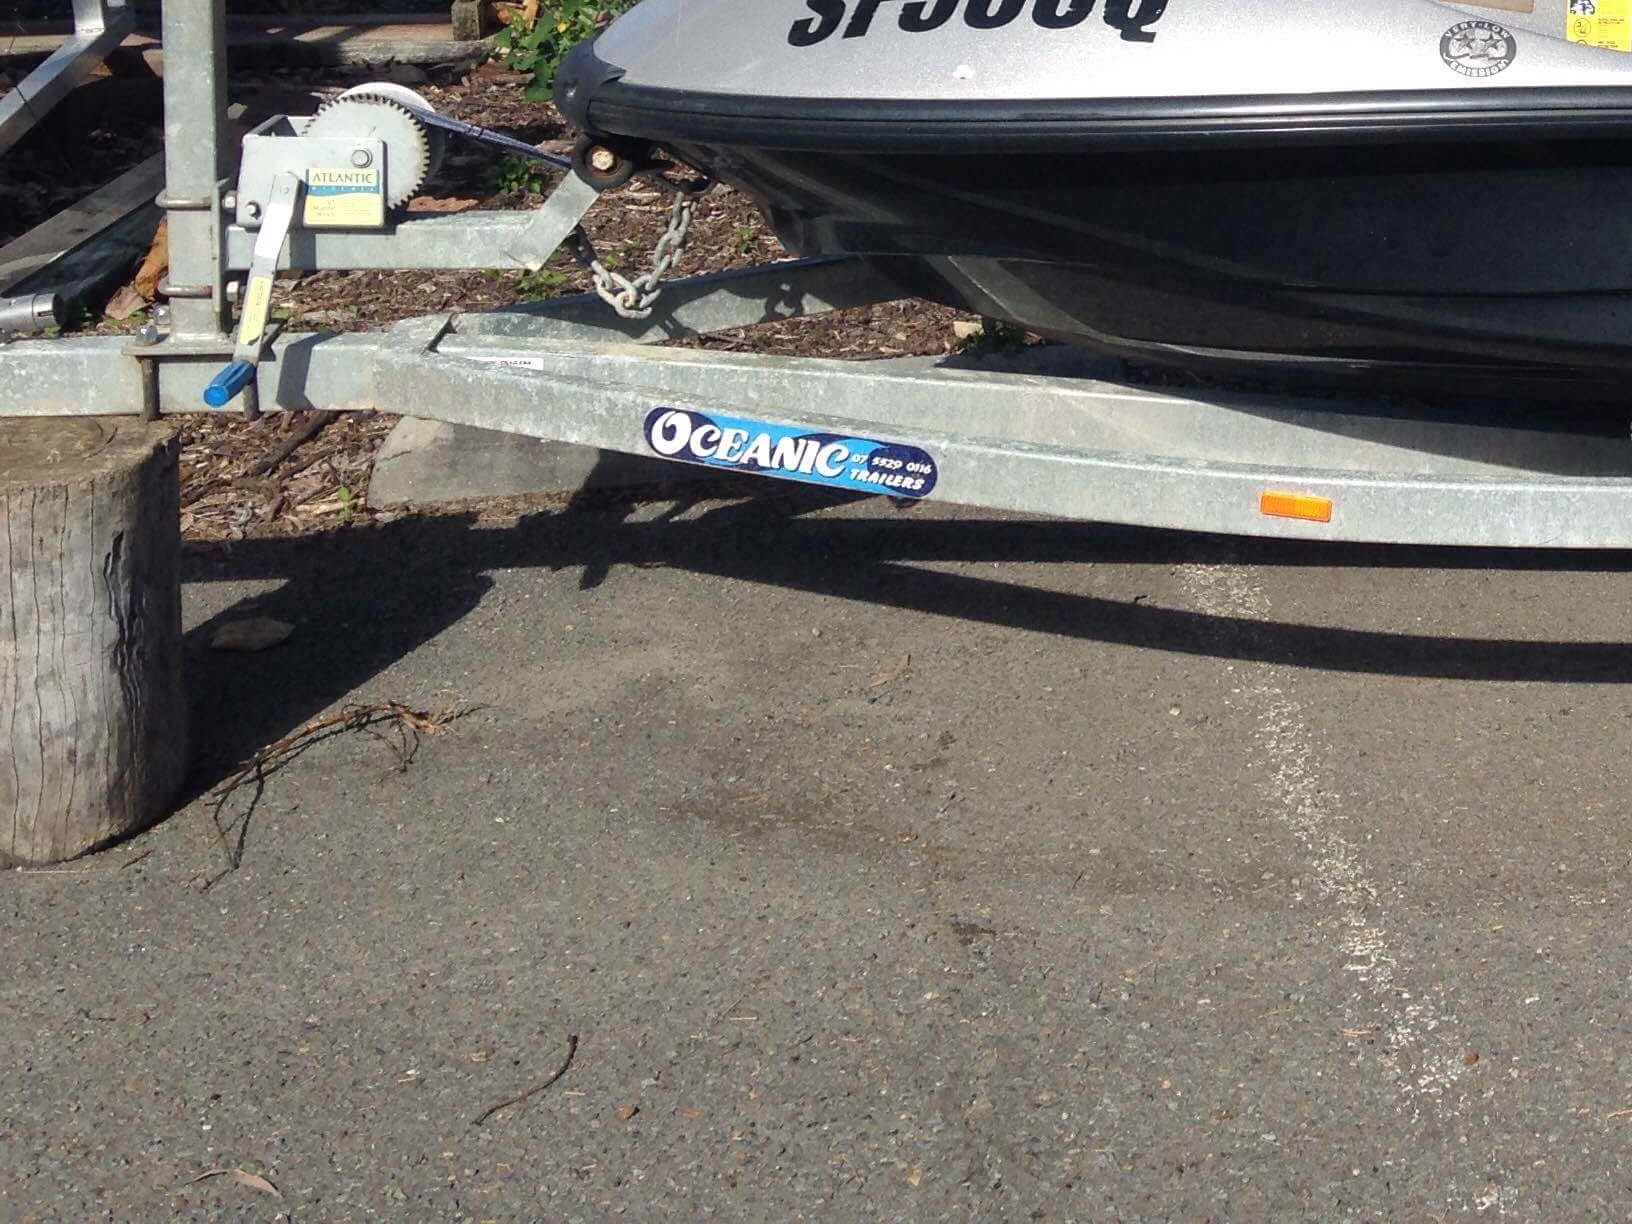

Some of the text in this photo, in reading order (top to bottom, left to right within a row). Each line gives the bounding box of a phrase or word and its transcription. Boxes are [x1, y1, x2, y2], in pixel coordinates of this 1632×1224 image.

[313, 172, 374, 184] ATLANTIC
[651, 411, 851, 477] OCEANIC
[872, 457, 903, 470] 5529
[906, 462, 932, 474] 0116
[849, 468, 925, 490] TRAILERS
